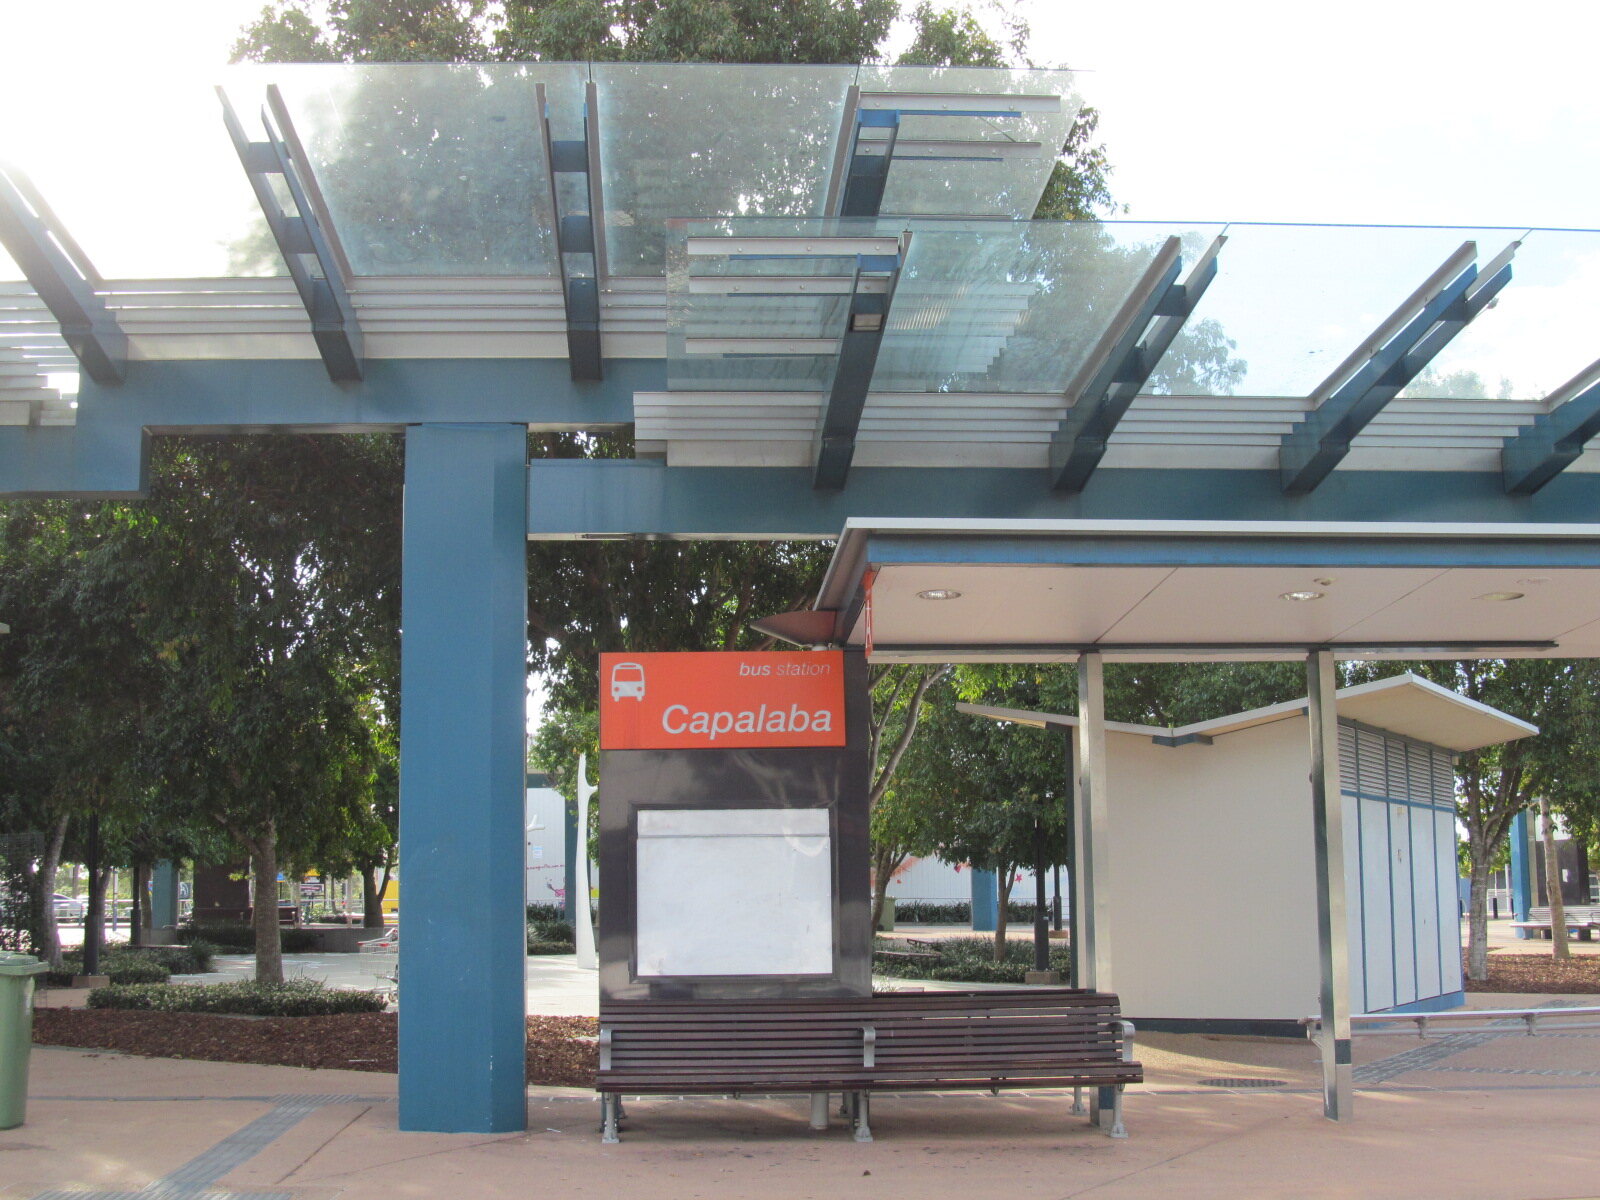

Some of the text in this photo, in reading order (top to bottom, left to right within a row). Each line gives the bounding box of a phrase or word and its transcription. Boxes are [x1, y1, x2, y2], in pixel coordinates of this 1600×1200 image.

[739, 662, 831, 676] bus station
[662, 704, 832, 740] Capalaba
